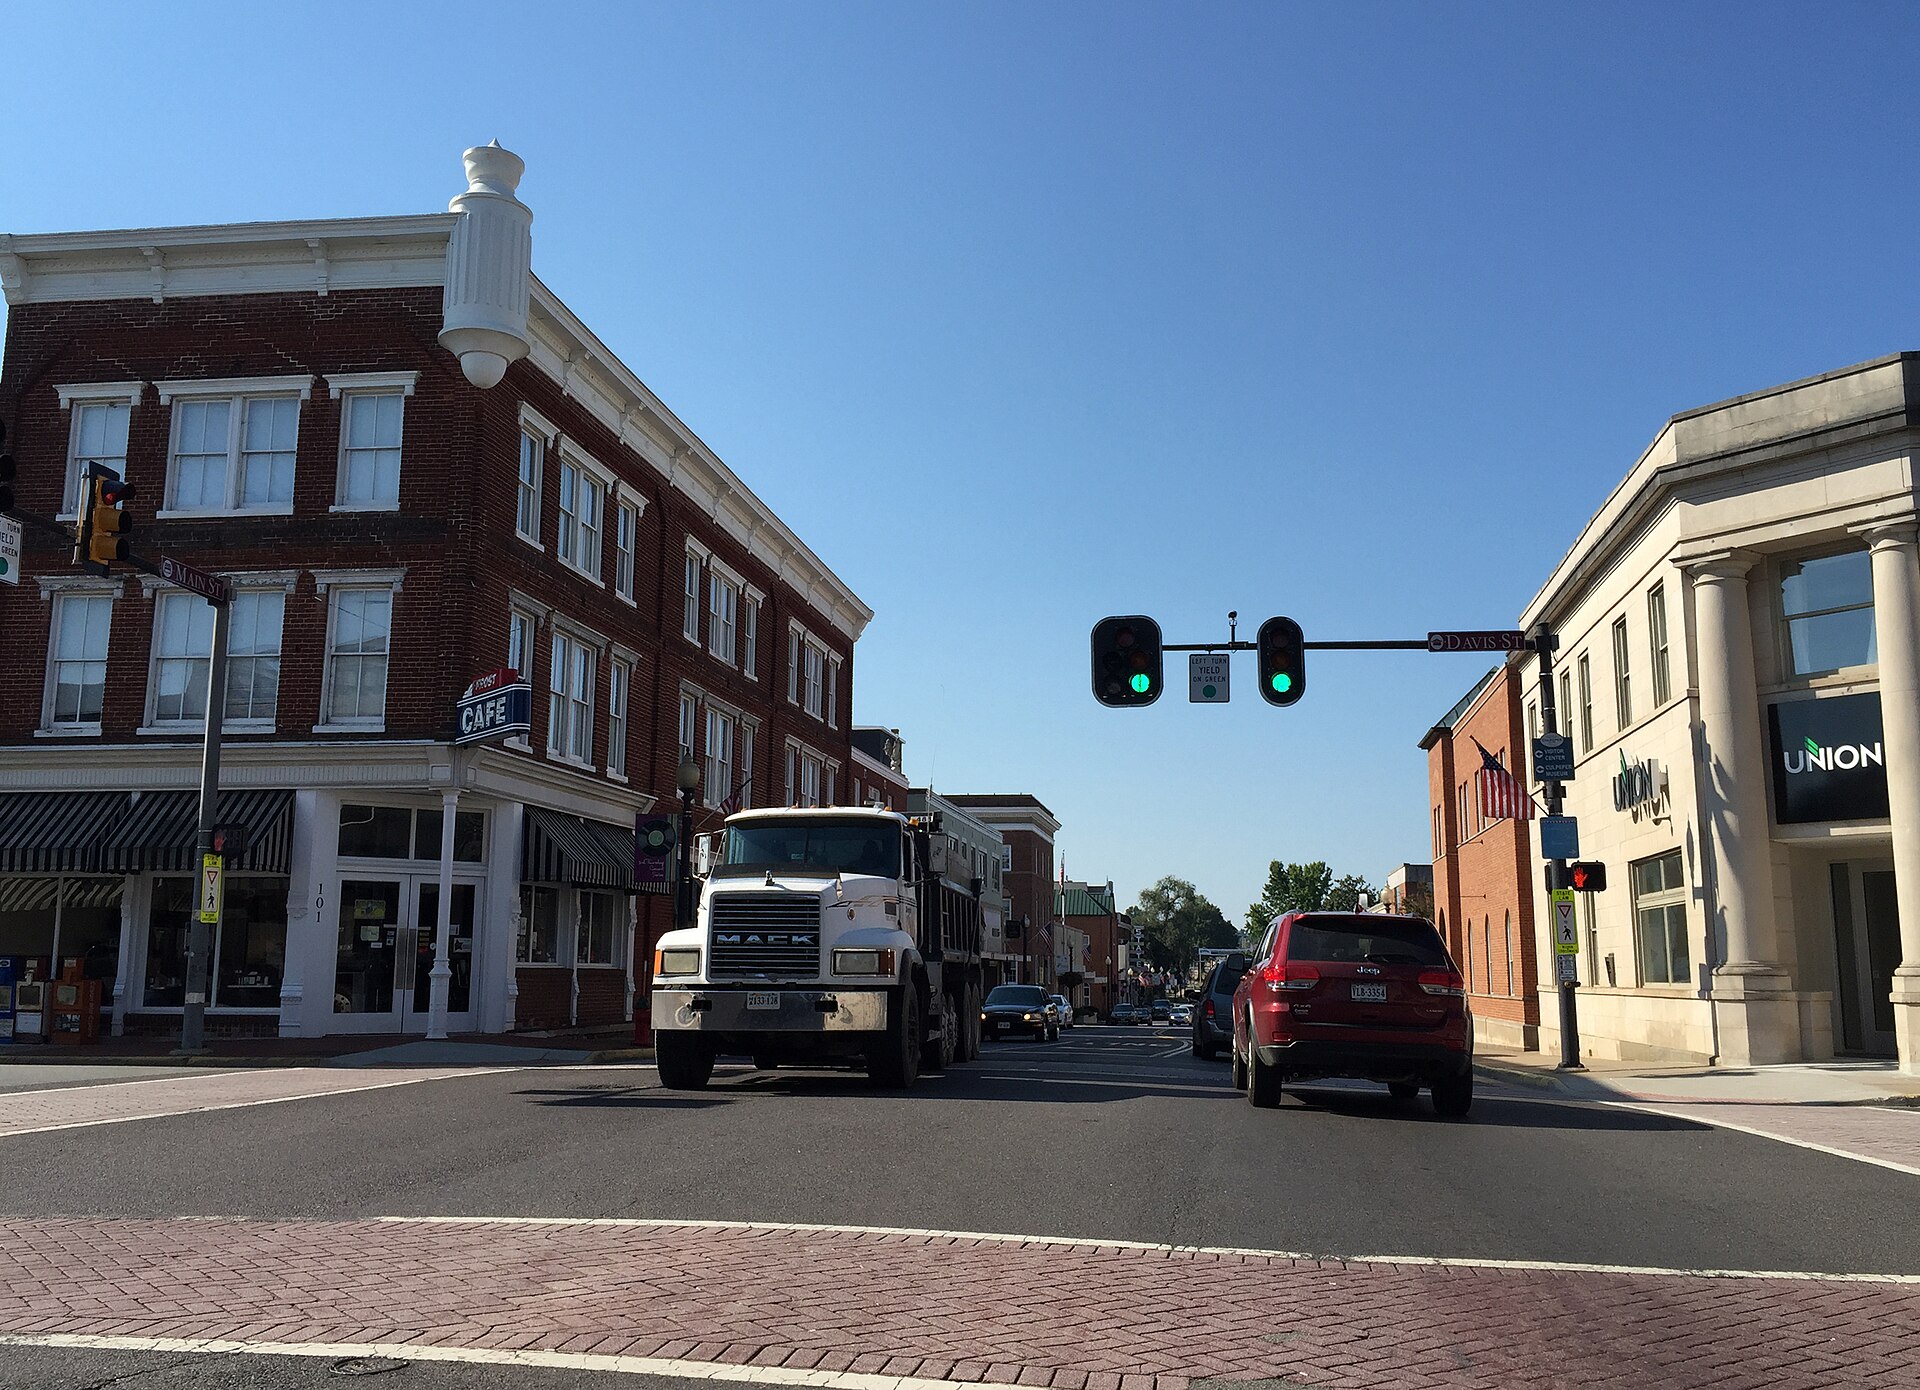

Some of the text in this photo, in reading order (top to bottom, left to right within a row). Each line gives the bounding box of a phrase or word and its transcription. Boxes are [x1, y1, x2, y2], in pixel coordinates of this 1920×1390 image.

[7, 523, 20, 534] TURN
[1, 546, 18, 557] GREEN
[176, 564, 206, 591] MAIN
[1445, 633, 1523, 650] DAVIS ST
[1199, 666, 1220, 674] YIELD
[461, 696, 507, 734] CAFE
[1783, 736, 1883, 774] UNION
[1612, 749, 1654, 812] UNION
[716, 935, 816, 945] MACK
[1356, 966, 1381, 975] Jeep
